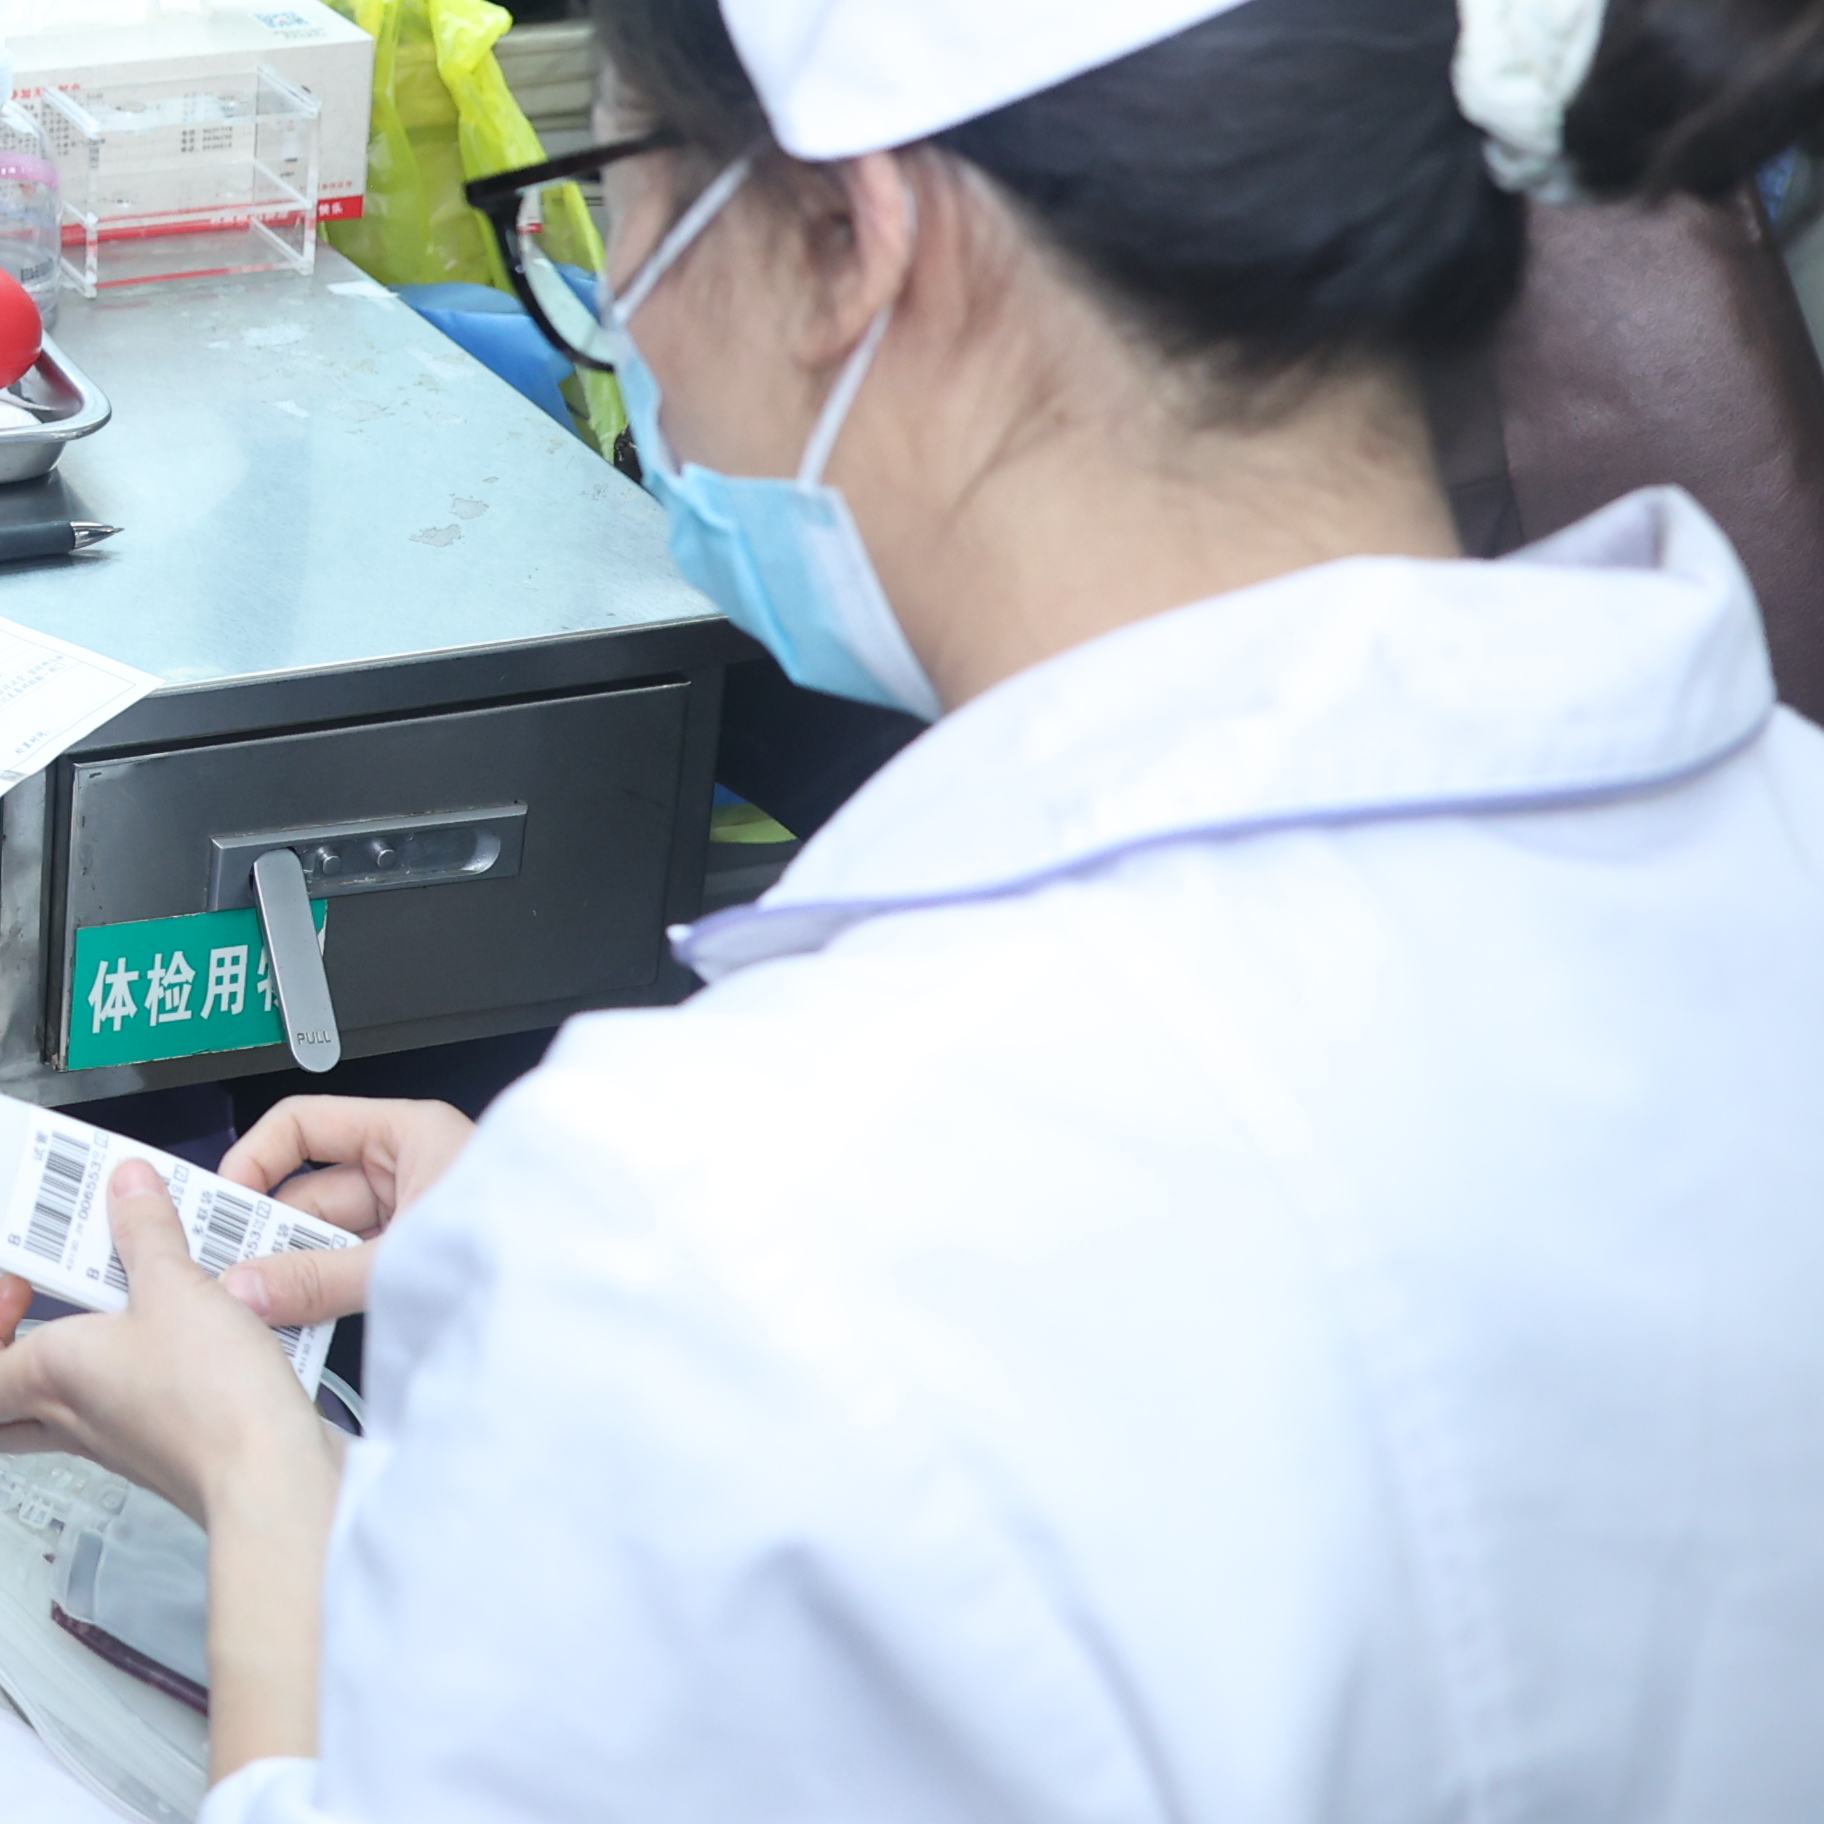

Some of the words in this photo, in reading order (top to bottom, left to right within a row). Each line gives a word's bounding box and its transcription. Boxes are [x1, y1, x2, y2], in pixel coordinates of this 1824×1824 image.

[297, 1031, 332, 1045] PULL
[7, 1232, 23, 1247] B
[86, 1267, 100, 1281] B
